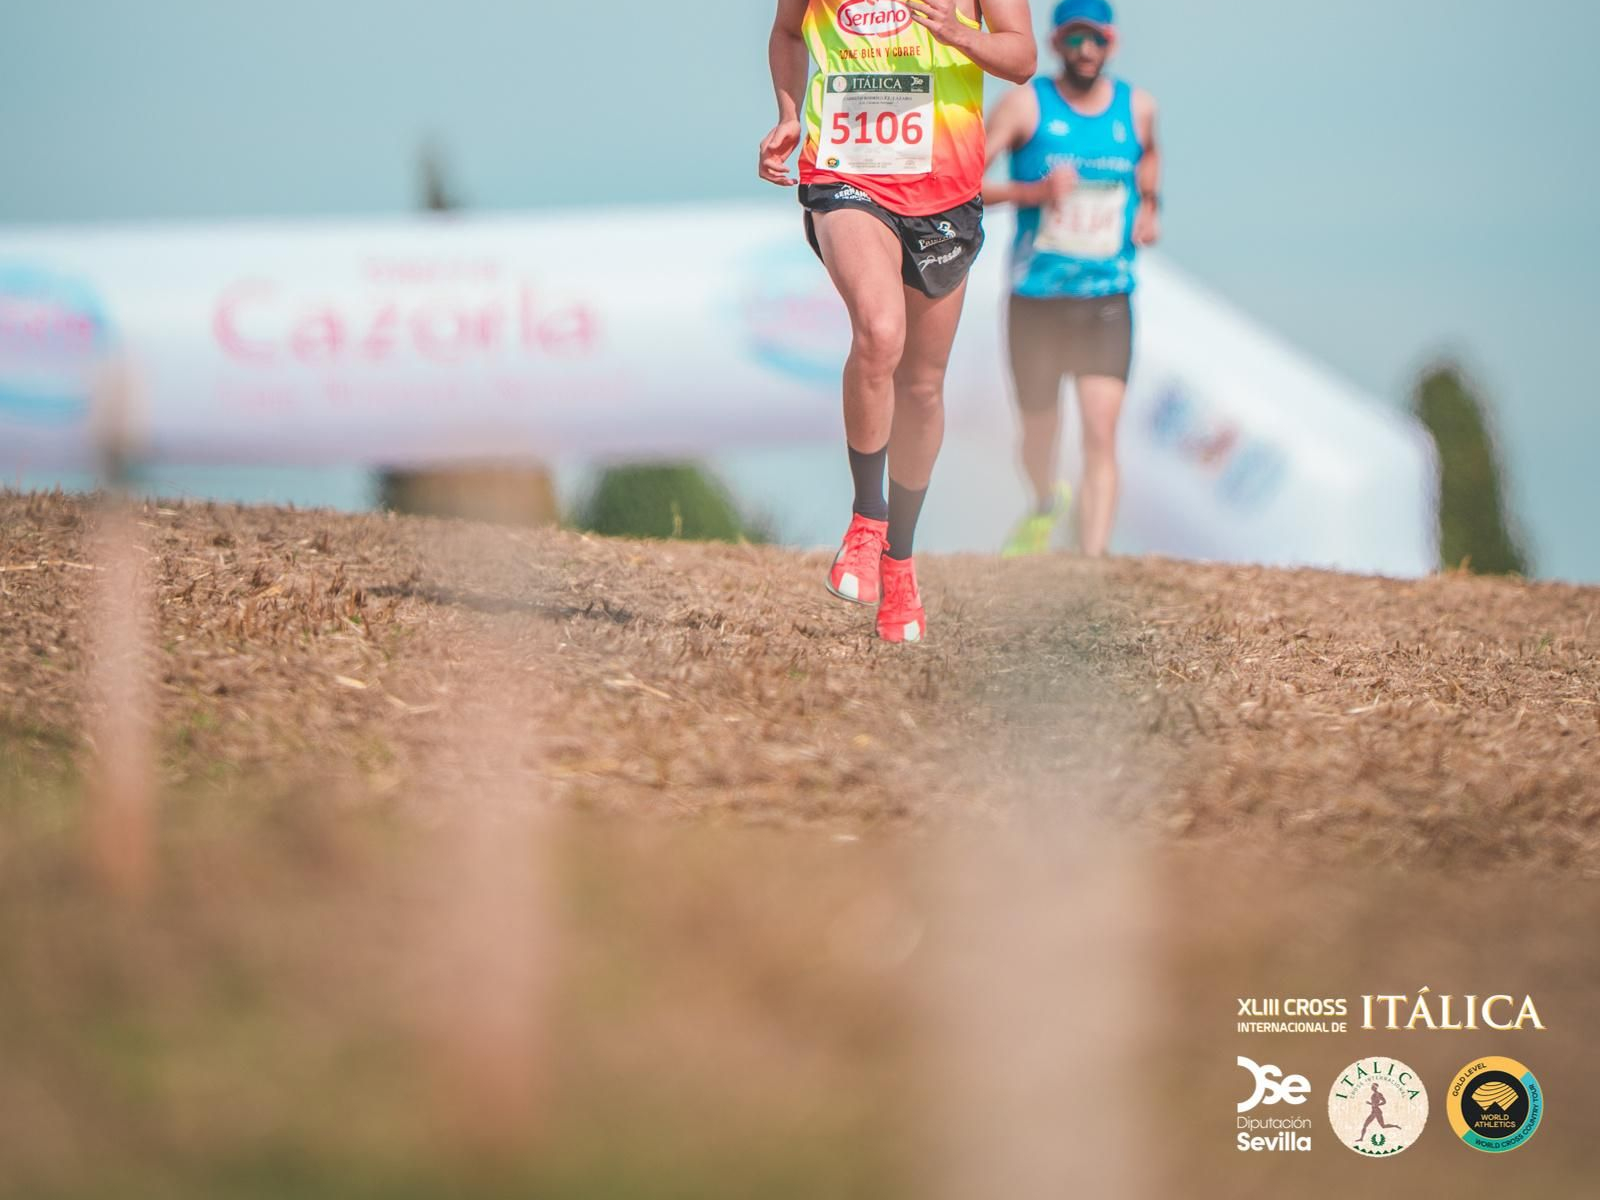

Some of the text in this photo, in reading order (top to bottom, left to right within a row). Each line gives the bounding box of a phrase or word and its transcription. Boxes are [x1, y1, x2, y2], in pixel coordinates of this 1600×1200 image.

[843, 8, 907, 27] Serrano
[861, 47, 882, 59] BIEN
[885, 47, 890, 57] Y
[892, 45, 921, 57] CORRE
[852, 76, 902, 90] ITÁLICA
[830, 111, 923, 145] 5106
